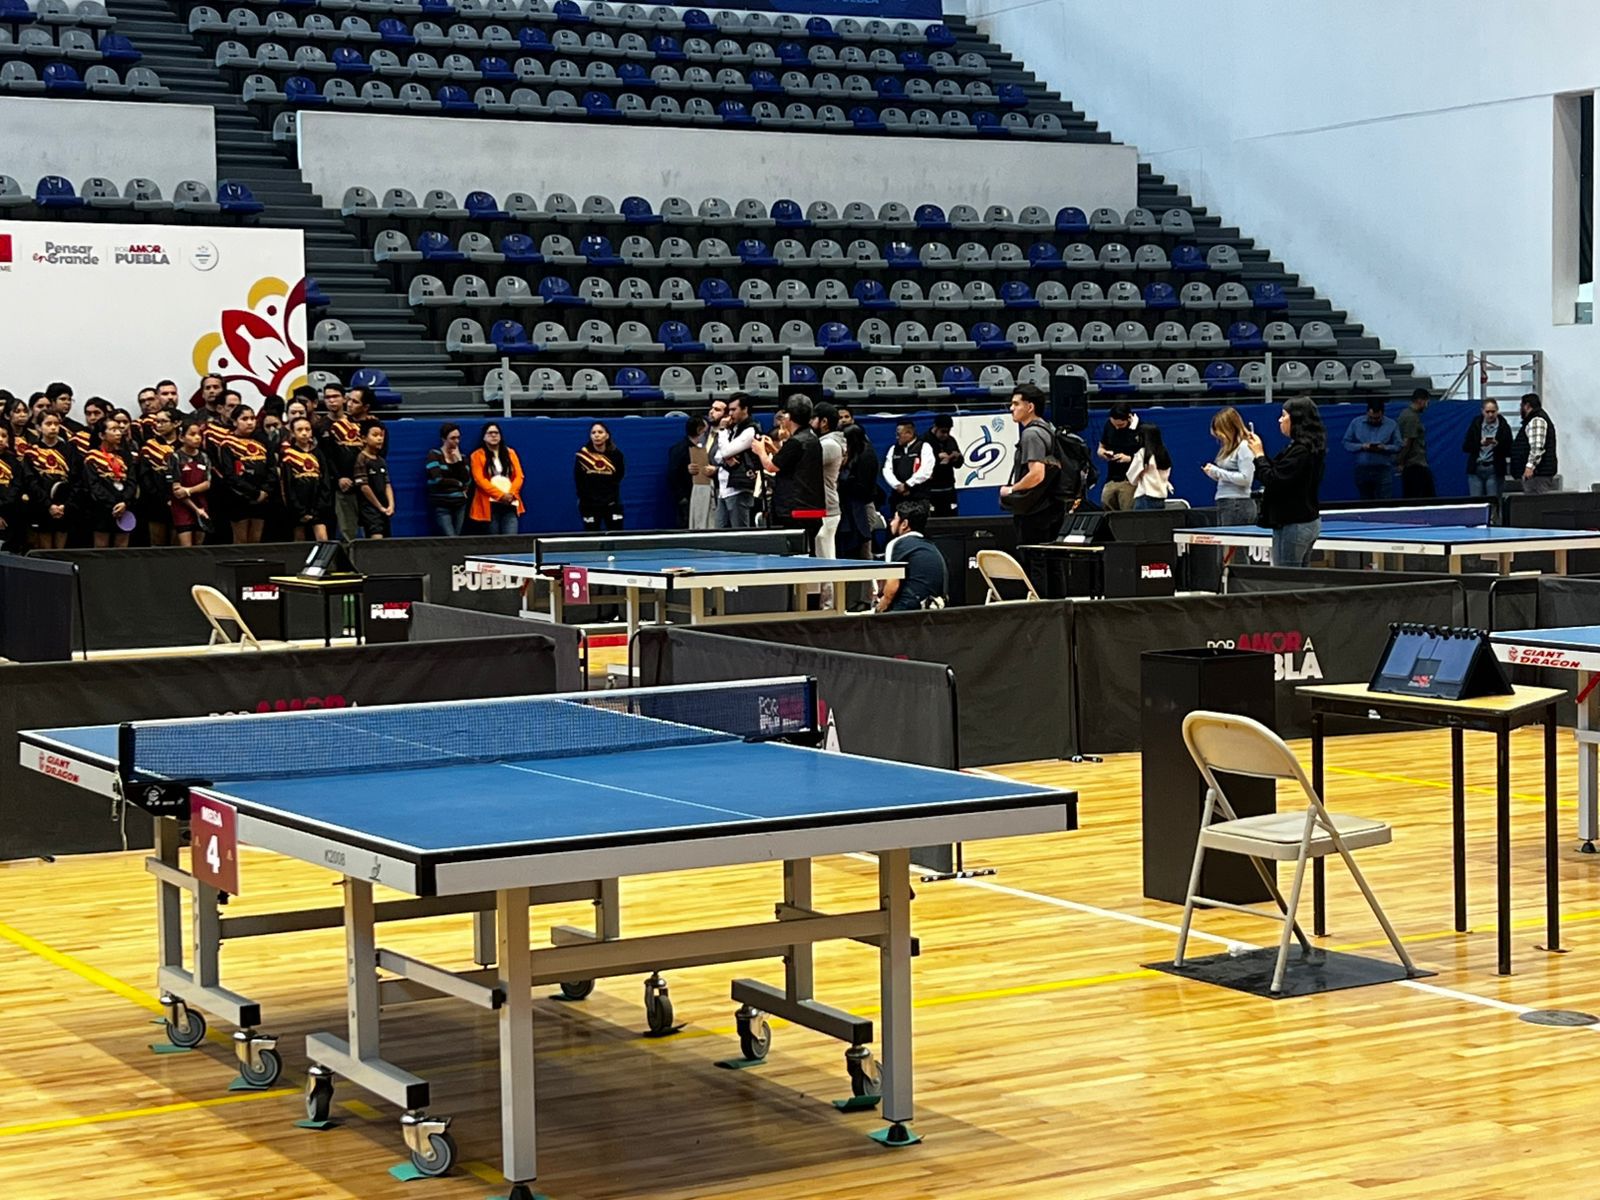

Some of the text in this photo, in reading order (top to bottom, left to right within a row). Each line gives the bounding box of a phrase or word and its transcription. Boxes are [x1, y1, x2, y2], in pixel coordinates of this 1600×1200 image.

[45, 241, 93, 254] Pensar
[129, 245, 161, 253] AMOR
[48, 253, 99, 265] Grande
[115, 253, 170, 265] PUEBLA
[571, 582, 580, 598] 9
[1237, 630, 1303, 653] AMOR
[1302, 636, 1314, 651] A
[1523, 649, 1565, 659] GIANT
[1274, 652, 1323, 681] BLA
[1520, 656, 1580, 668] DRAGON
[46, 755, 71, 769] GIANT
[44, 765, 80, 783] DRAGON
[206, 834, 221, 874] 4
